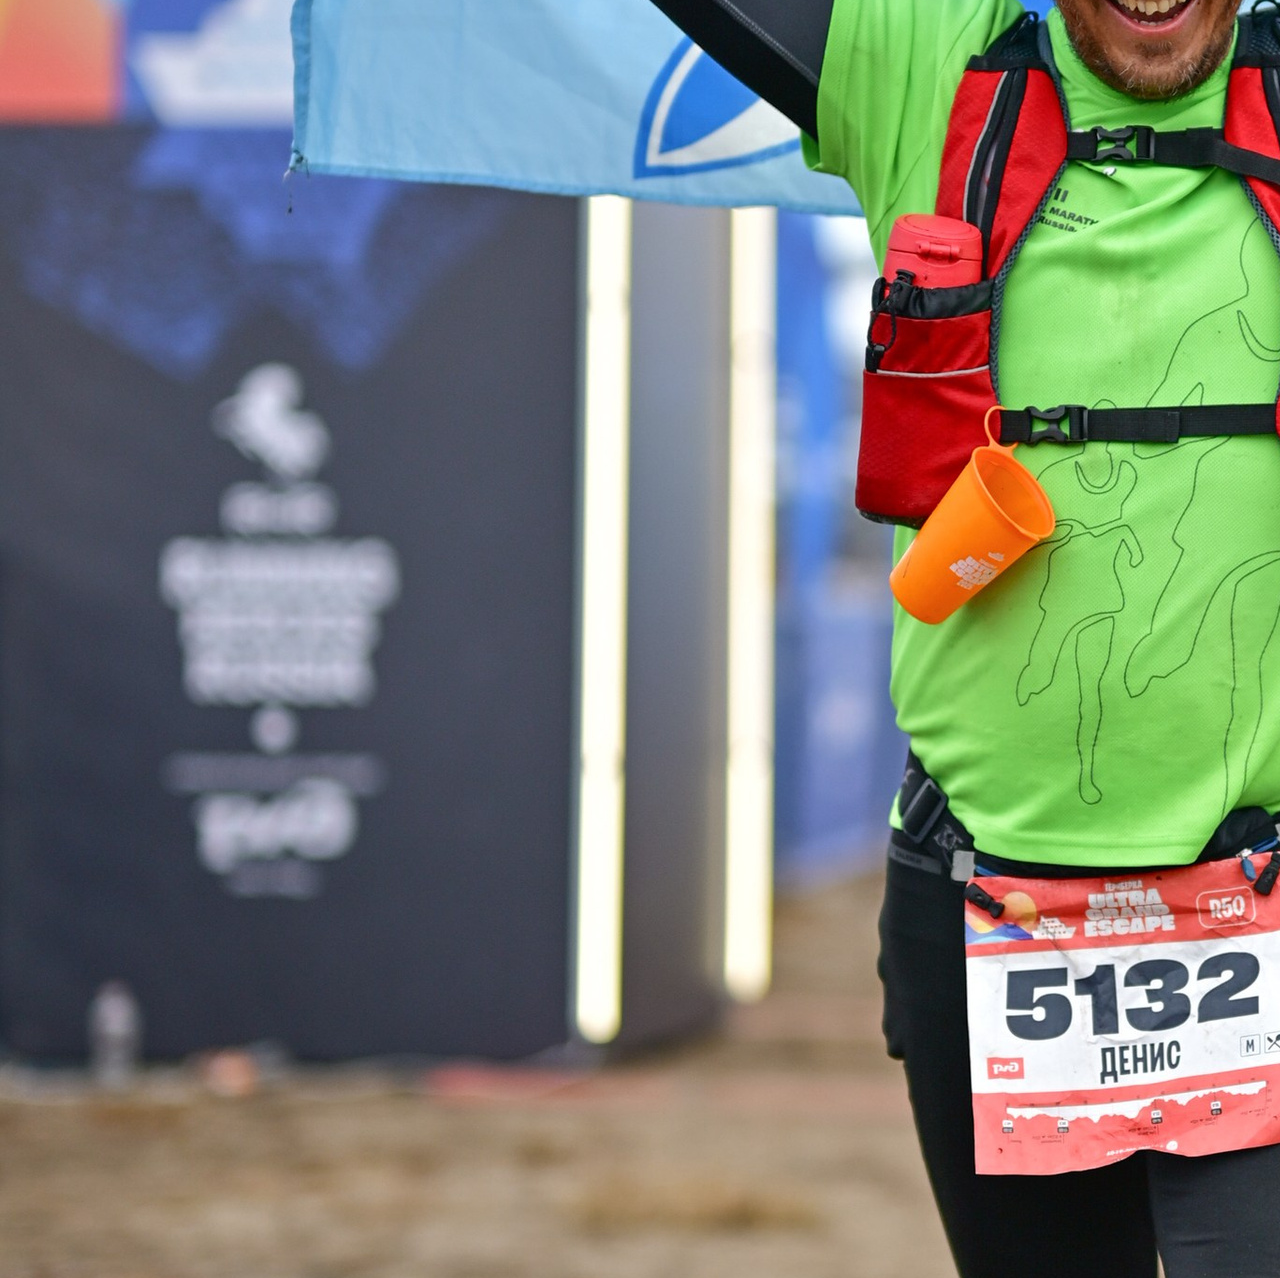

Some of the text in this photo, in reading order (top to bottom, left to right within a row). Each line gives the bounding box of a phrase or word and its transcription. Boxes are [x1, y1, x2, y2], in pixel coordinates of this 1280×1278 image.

[1088, 888, 1163, 909] ULTRA
[1209, 895, 1246, 920] R50
[1085, 904, 1170, 921] GRAND
[1084, 914, 1176, 938] ESCAPE
[1005, 951, 1260, 1041] 5132
[1100, 1040, 1182, 1084] ДЕНИС
